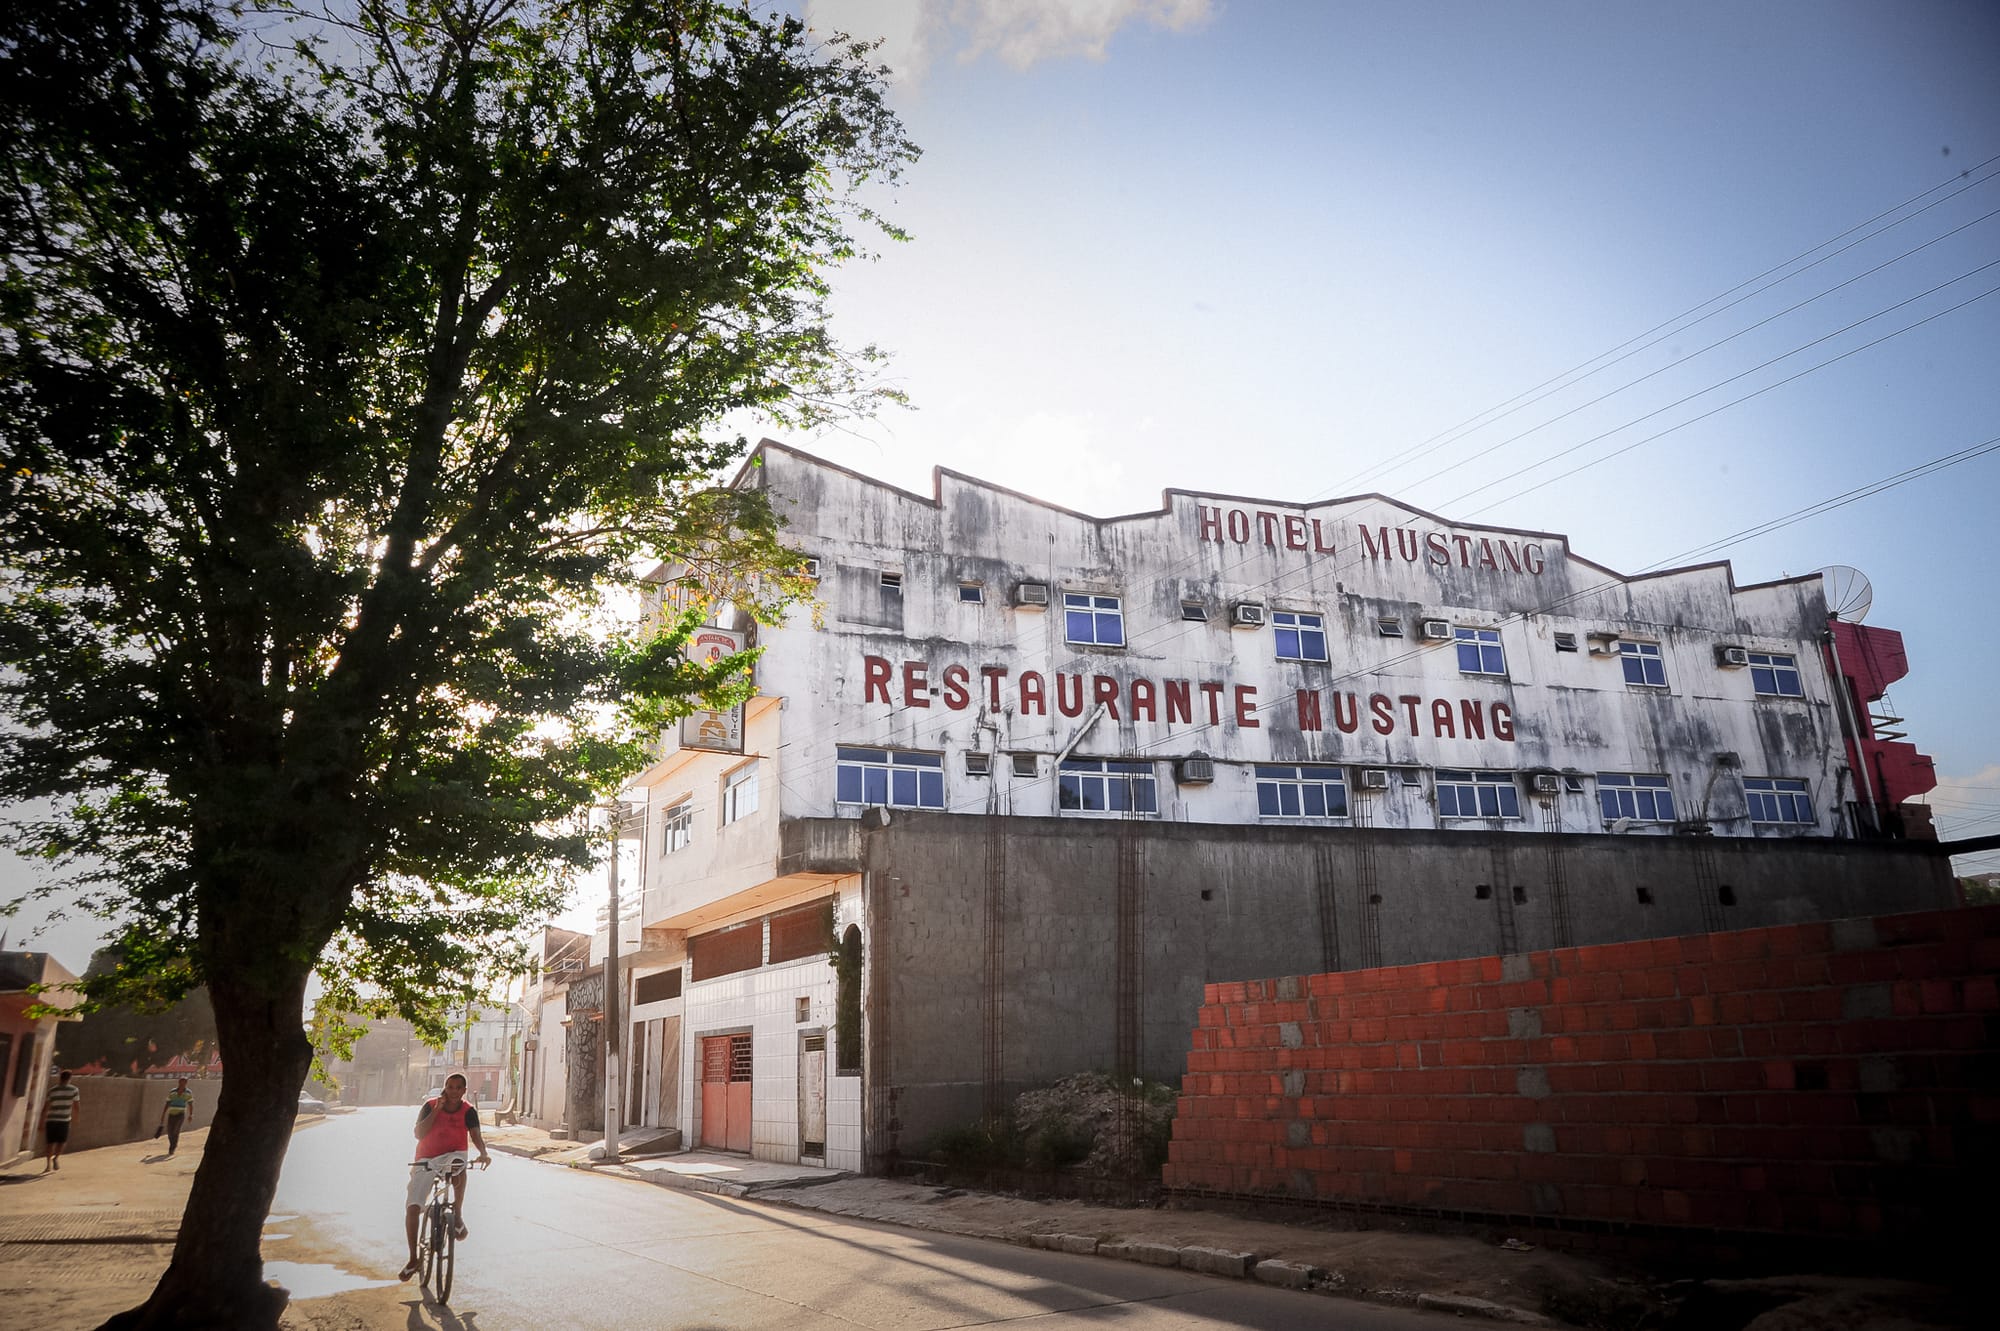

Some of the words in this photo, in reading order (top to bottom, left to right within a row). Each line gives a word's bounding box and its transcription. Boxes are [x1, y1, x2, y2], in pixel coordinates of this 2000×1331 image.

[1199, 504, 1335, 554] HOTEL
[1358, 523, 1544, 576] MUSTANG
[864, 655, 1260, 728] RESTAURANTE
[1296, 689, 1516, 742] MUSTANG
